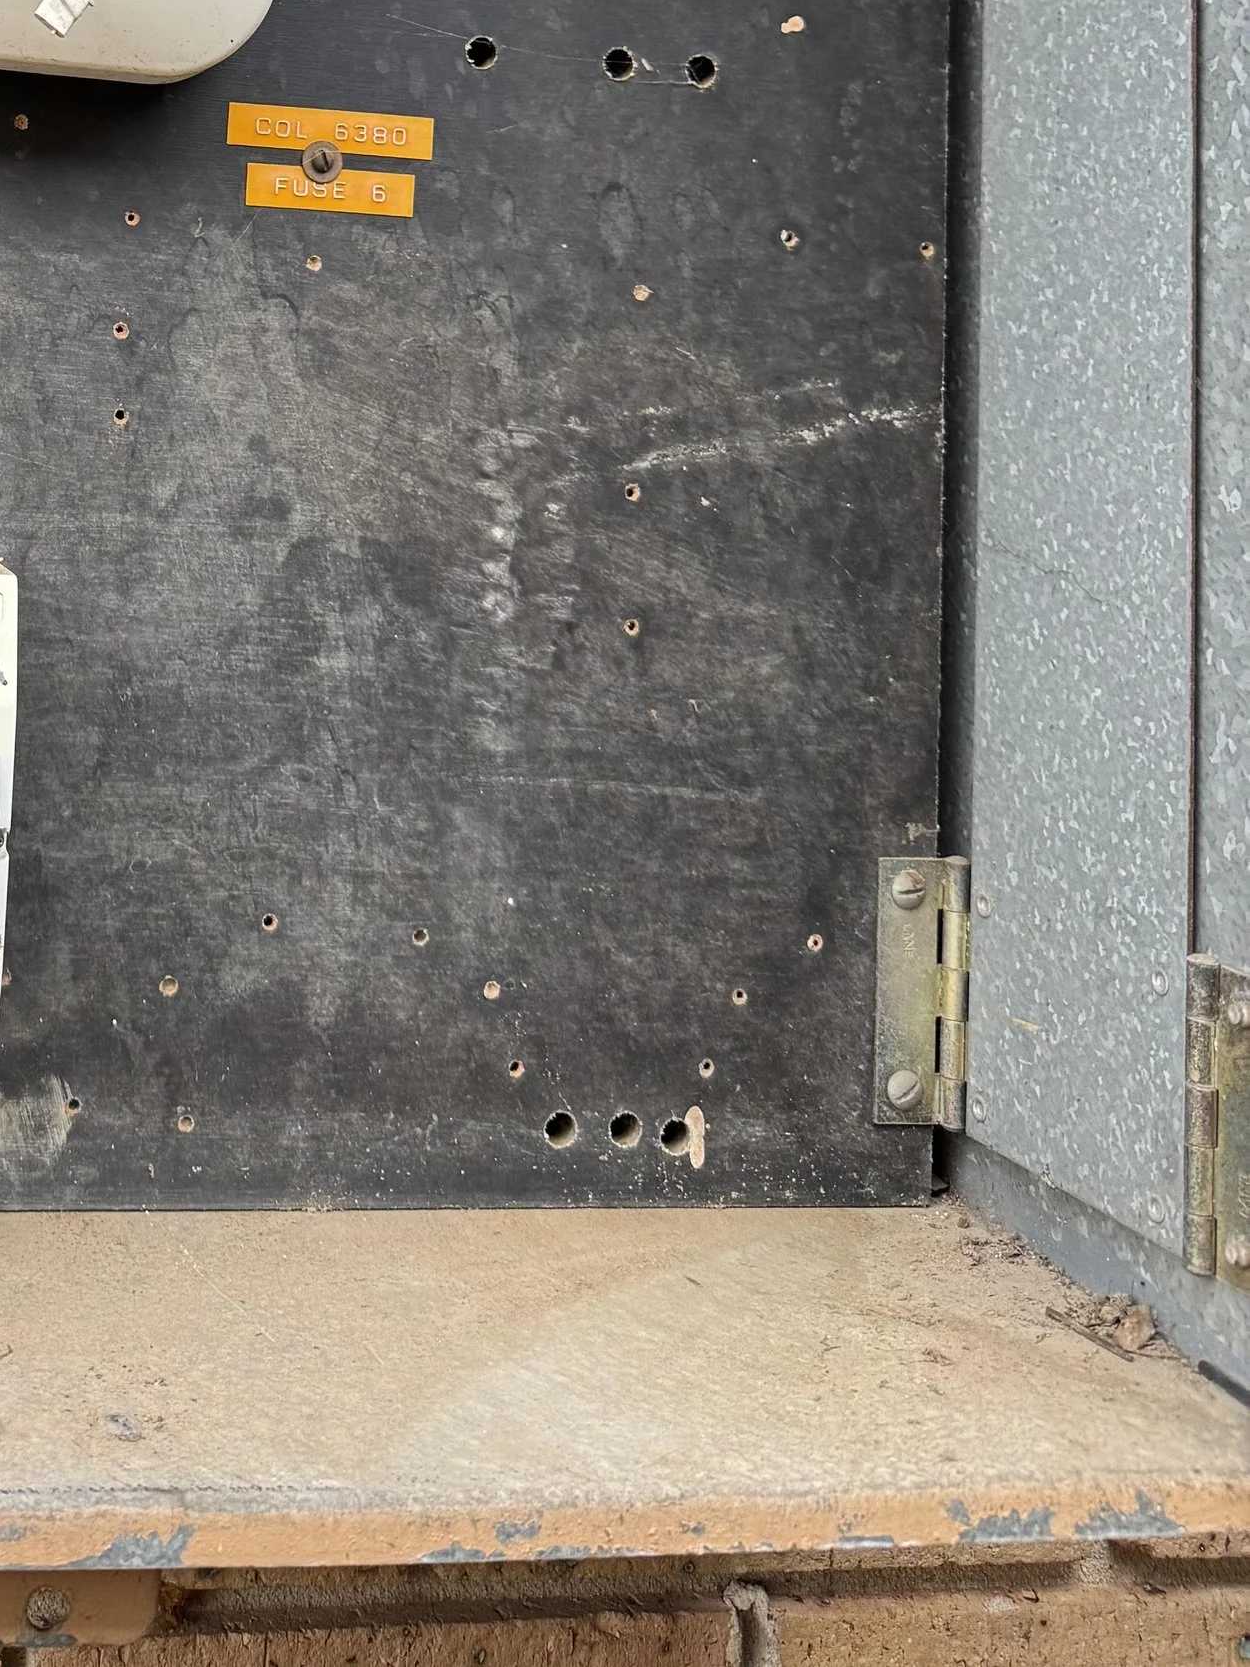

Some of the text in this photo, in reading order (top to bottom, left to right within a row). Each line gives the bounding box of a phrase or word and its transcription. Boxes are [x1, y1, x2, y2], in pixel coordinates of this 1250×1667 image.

[255, 117, 407, 146] COL 6380
[274, 177, 387, 203] FUSE 6
